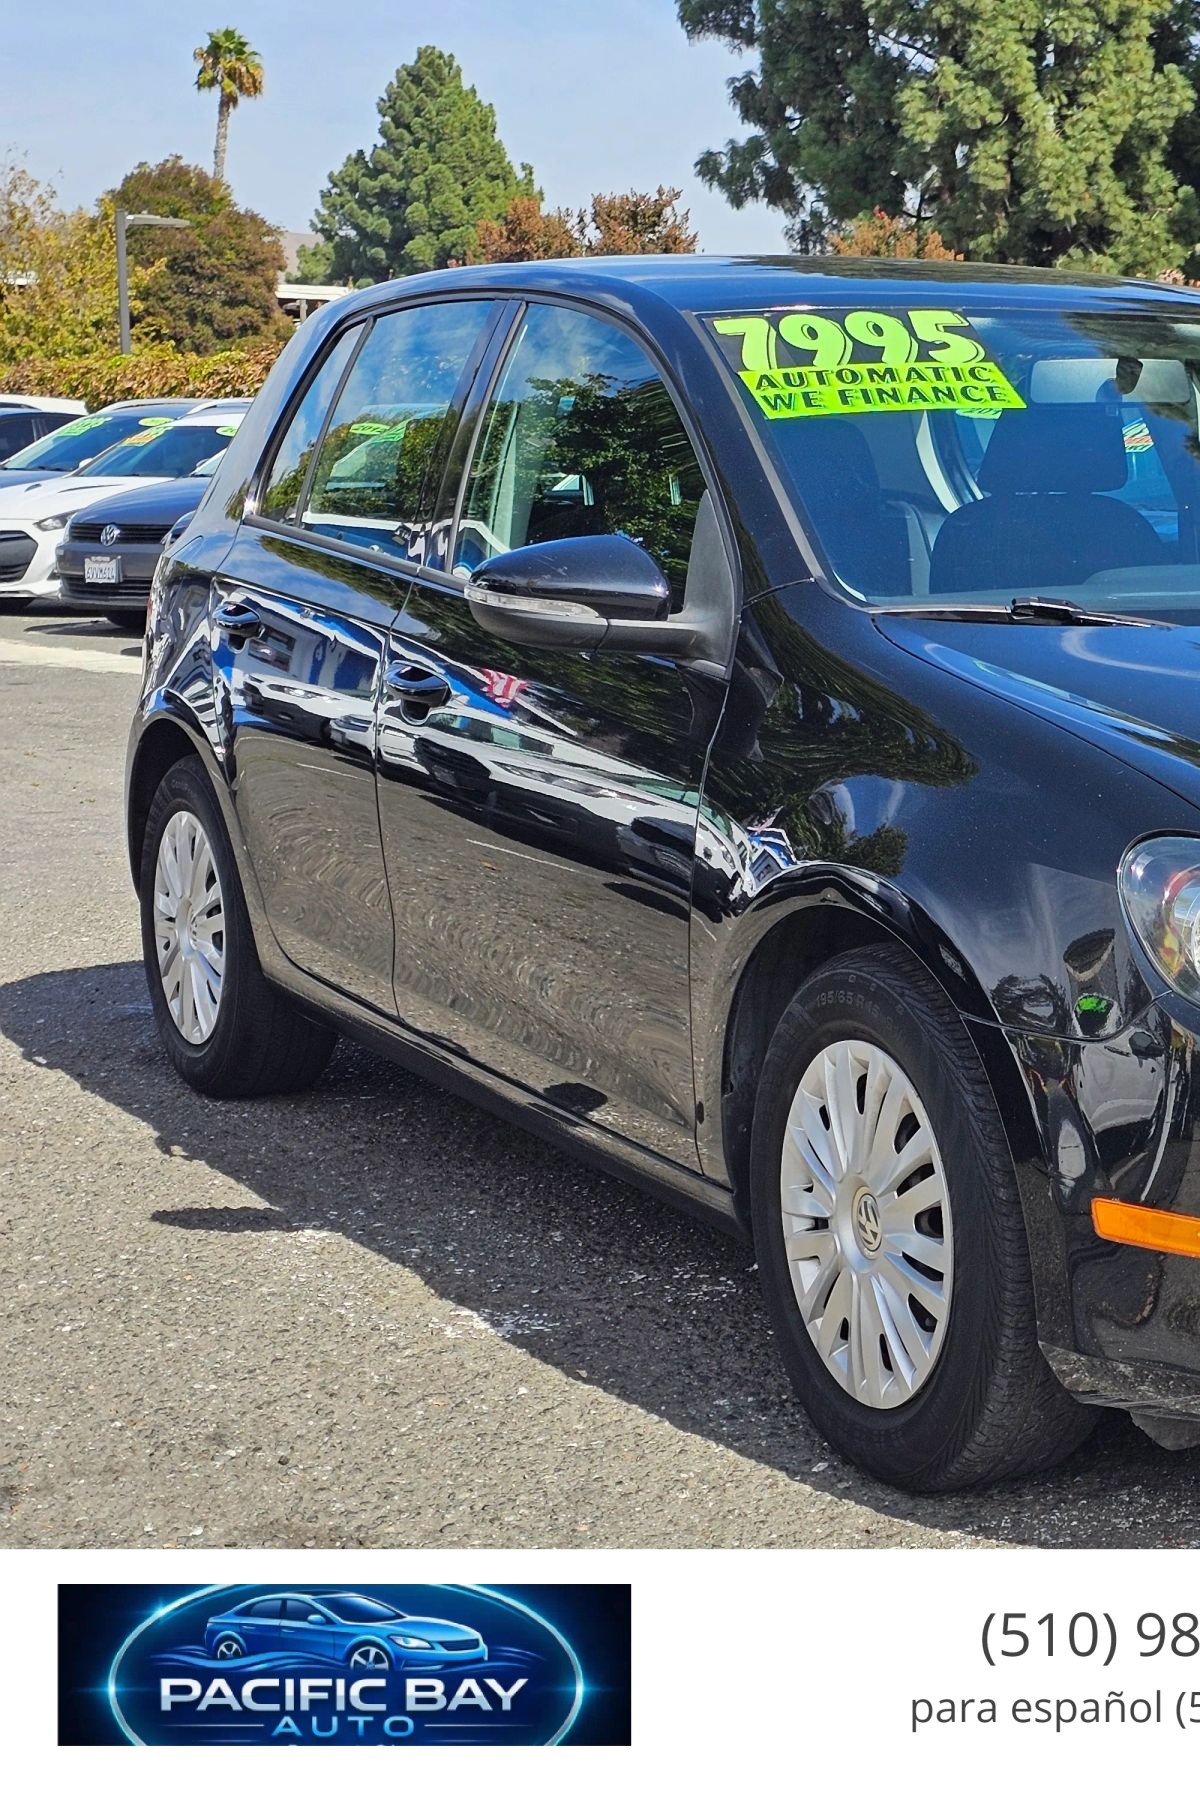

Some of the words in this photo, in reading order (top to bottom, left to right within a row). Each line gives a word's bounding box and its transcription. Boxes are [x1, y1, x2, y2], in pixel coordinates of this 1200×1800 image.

[712, 309, 986, 371] 7995
[755, 366, 994, 392] AUTOMATIC
[760, 390, 825, 412] WE
[839, 384, 1009, 406] FINANCE
